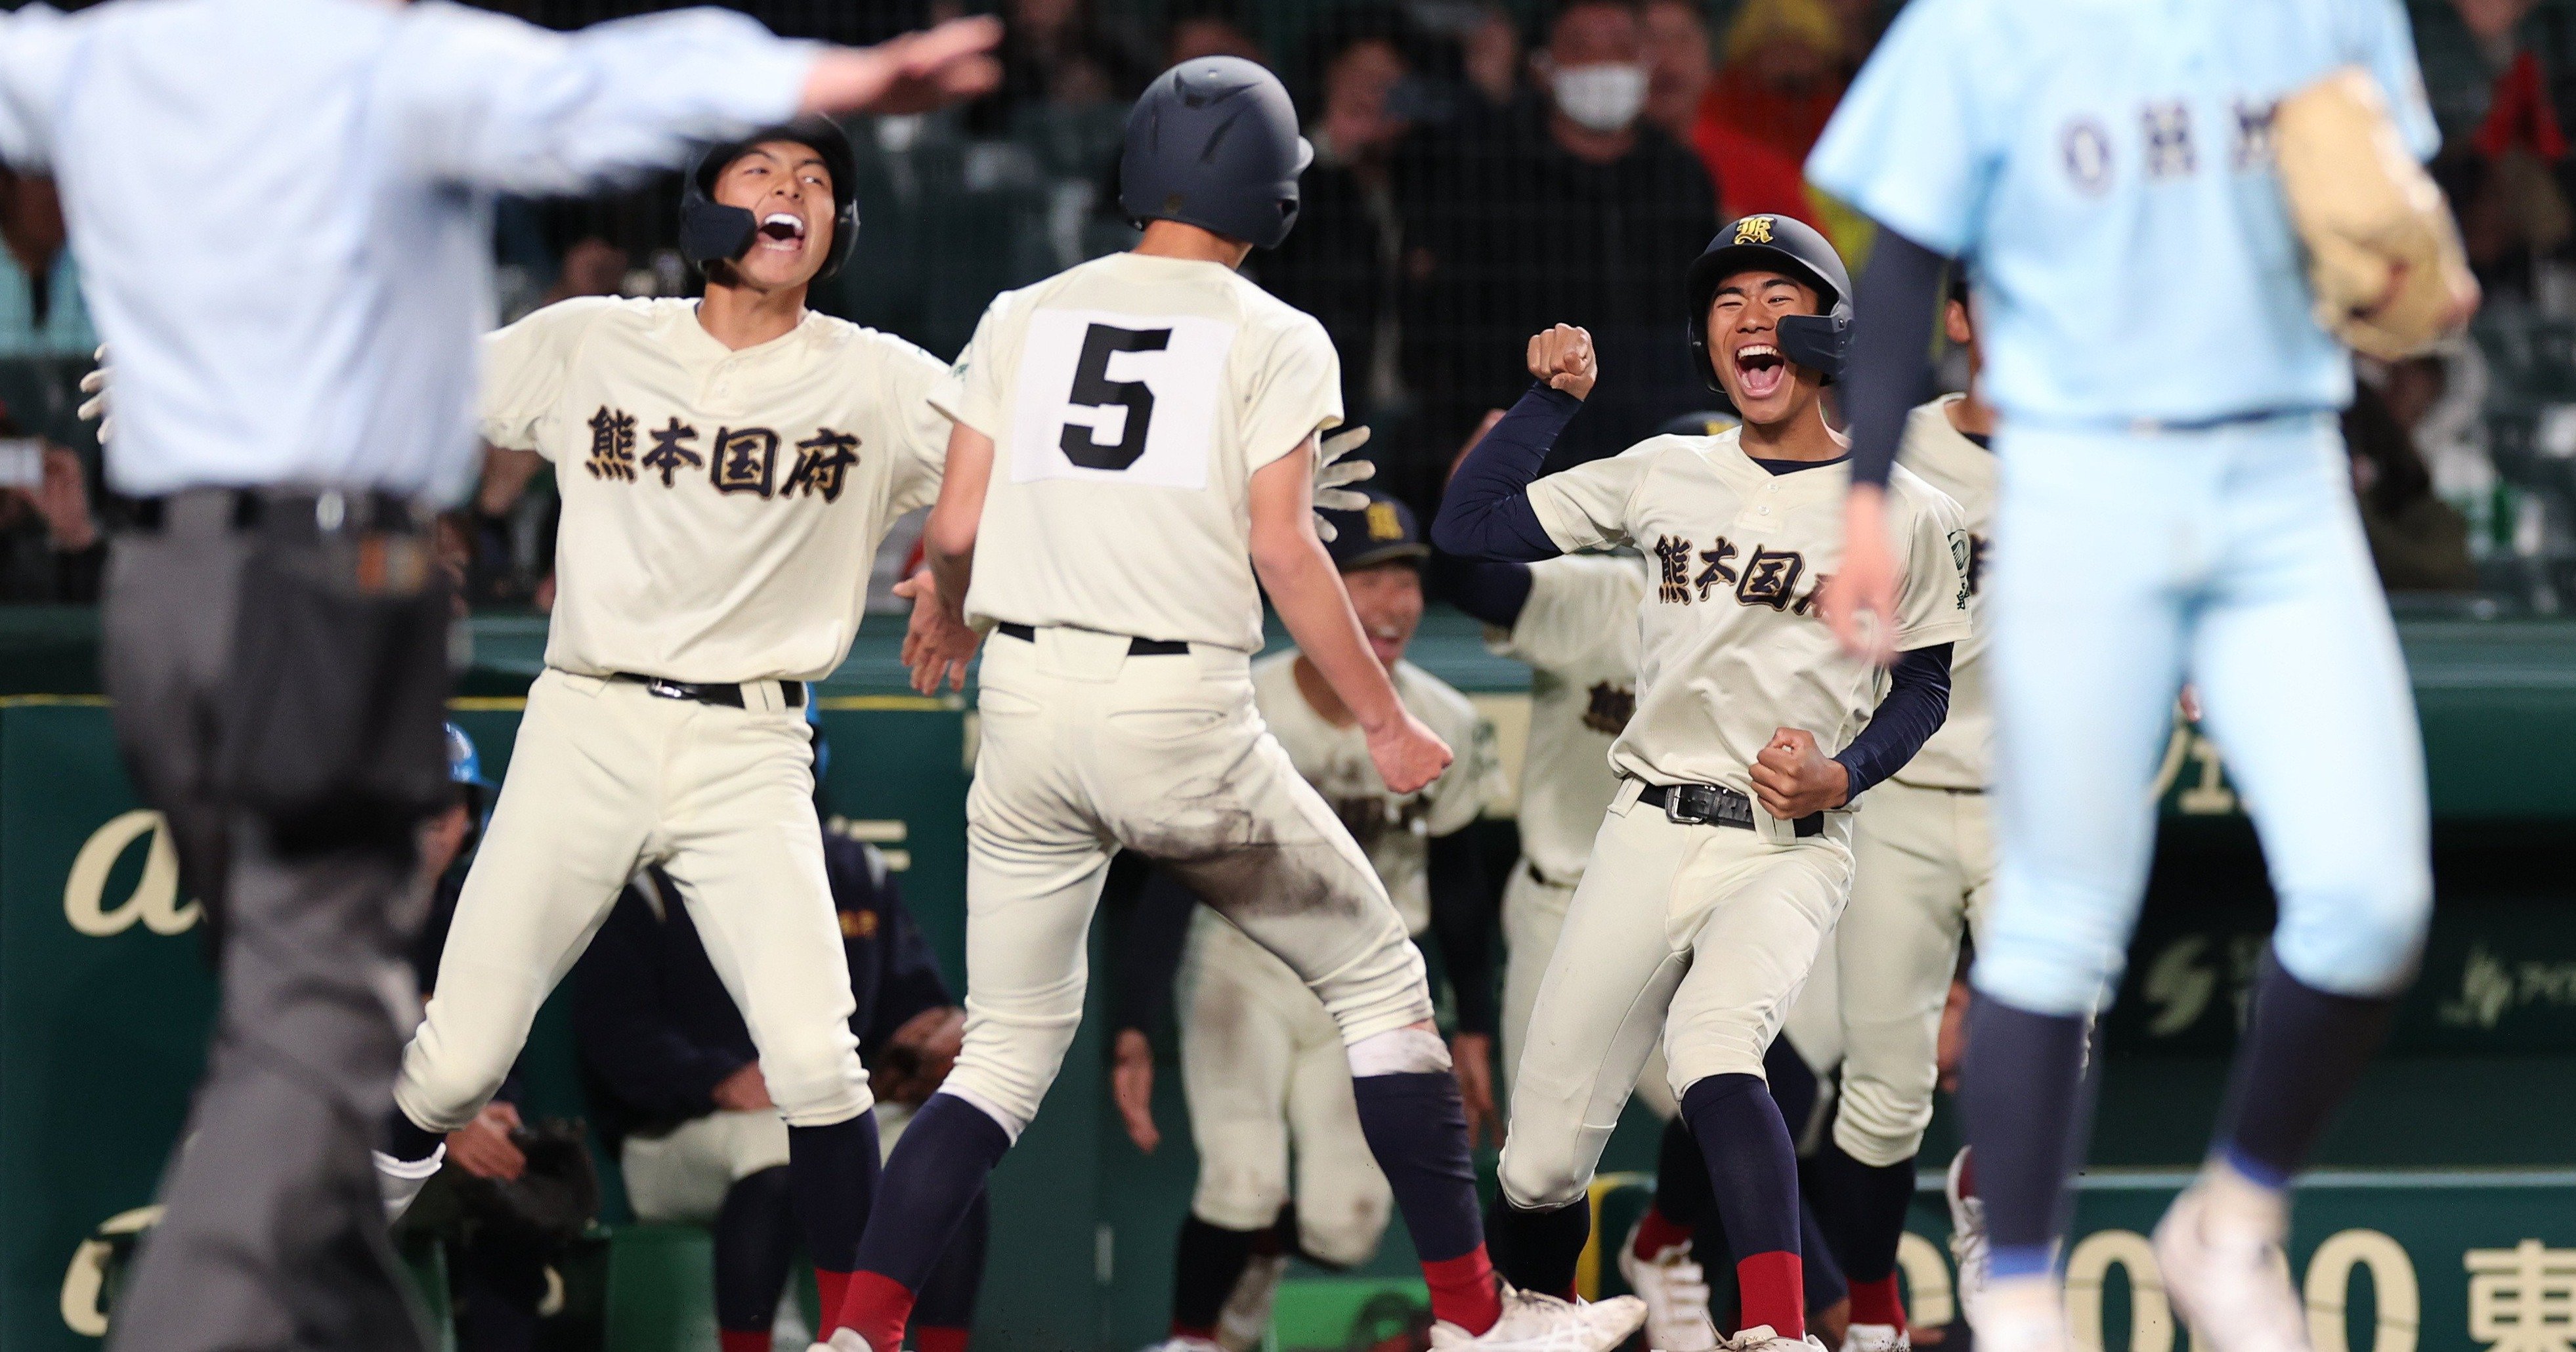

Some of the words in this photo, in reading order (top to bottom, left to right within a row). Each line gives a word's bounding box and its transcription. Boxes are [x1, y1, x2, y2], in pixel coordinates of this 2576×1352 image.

[585, 404, 862, 503] 熊本国府
[1059, 323, 1173, 471] 5
